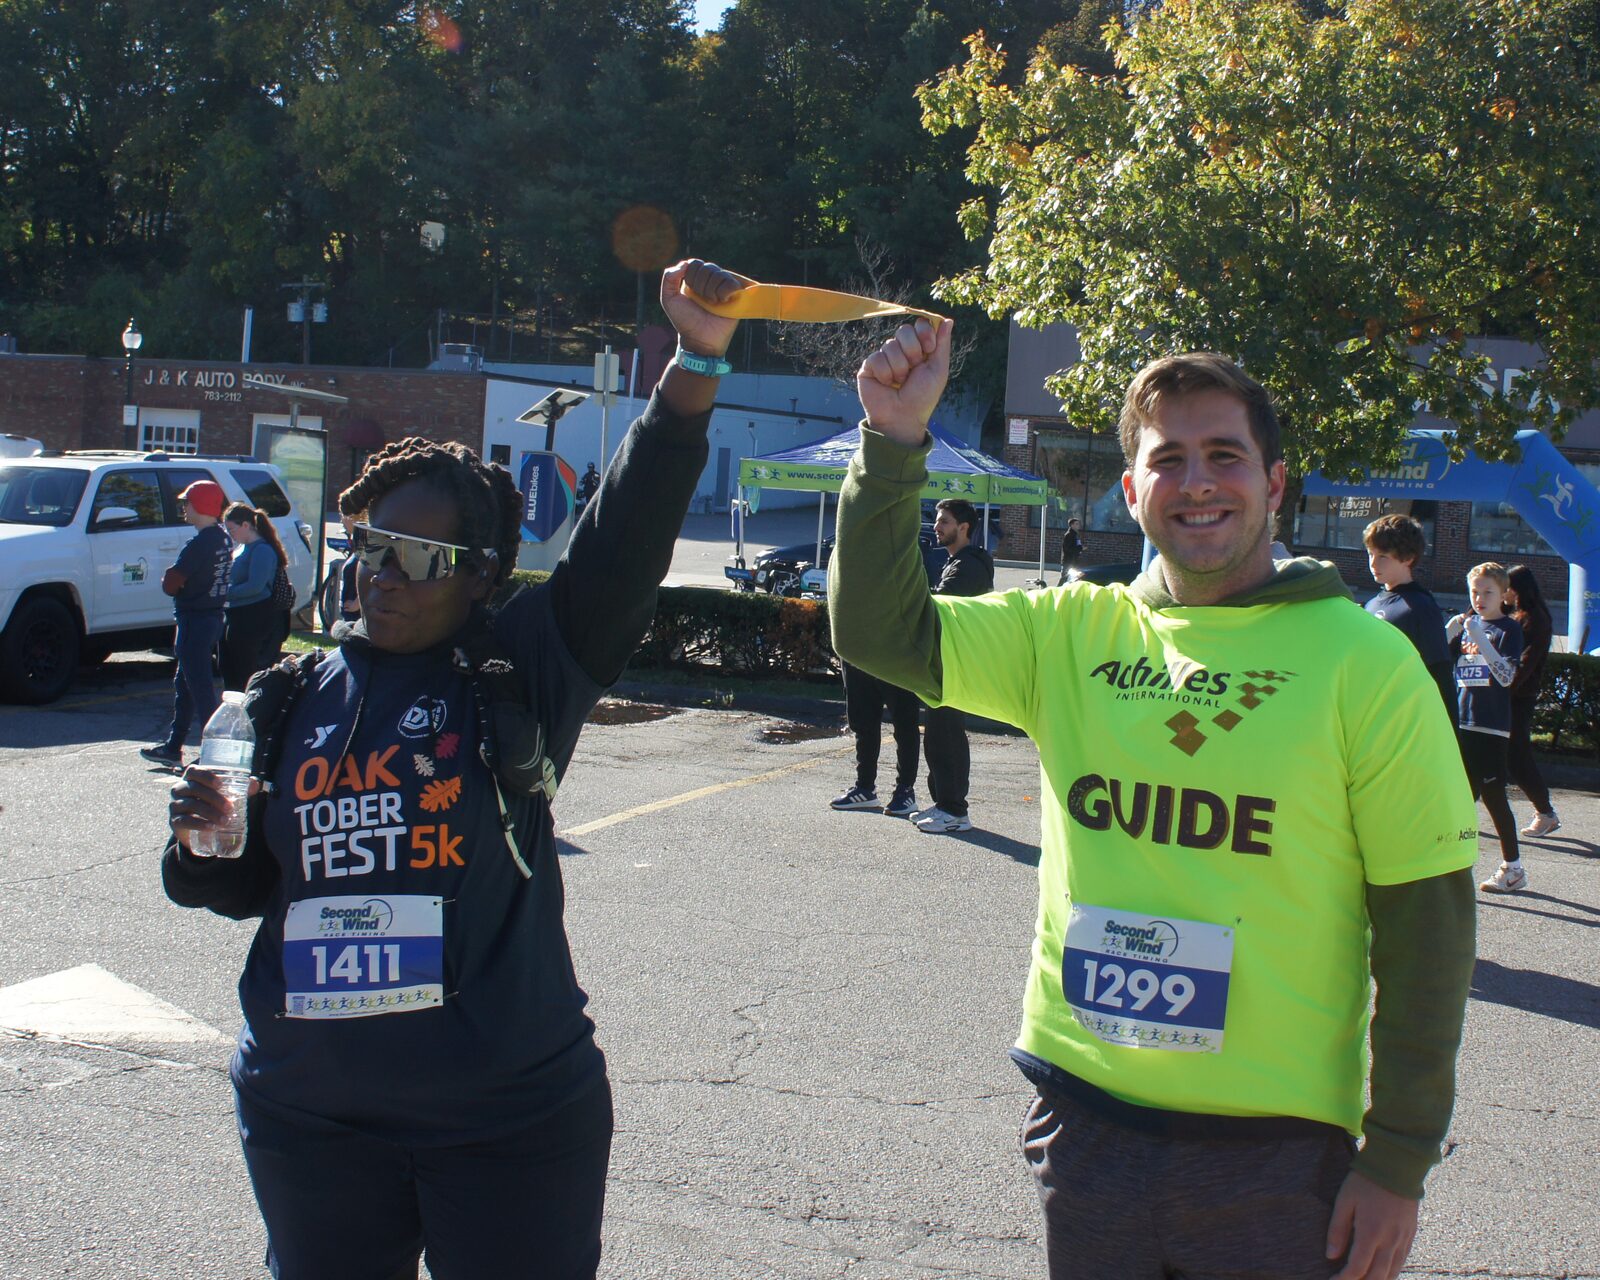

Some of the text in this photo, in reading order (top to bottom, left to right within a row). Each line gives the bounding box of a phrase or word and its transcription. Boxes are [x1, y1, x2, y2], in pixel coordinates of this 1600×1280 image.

[144, 370, 153, 385] J
[159, 370, 170, 385] &
[177, 370, 188, 386] K
[194, 371, 235, 389] AUTO
[204, 391, 242, 401] 783-2112
[527, 465, 539, 521] BLUEbikes
[1381, 481, 1436, 489] TIMING
[1090, 657, 1231, 695] Achilles
[1460, 666, 1482, 678] 1475
[1115, 692, 1221, 708] INTERNATIONAL
[295, 744, 401, 801] OAK
[294, 792, 404, 835] TOBER
[1067, 773, 1276, 857] GUIDE
[301, 823, 465, 881] FEST 5k
[320, 906, 371, 920] Second
[343, 918, 379, 930] Wind
[1104, 919, 1157, 940] Second
[1105, 949, 1168, 963] RACE TIMING
[1125, 937, 1163, 955] Wind
[312, 944, 400, 985] 1411
[1083, 959, 1196, 1016] 1299
